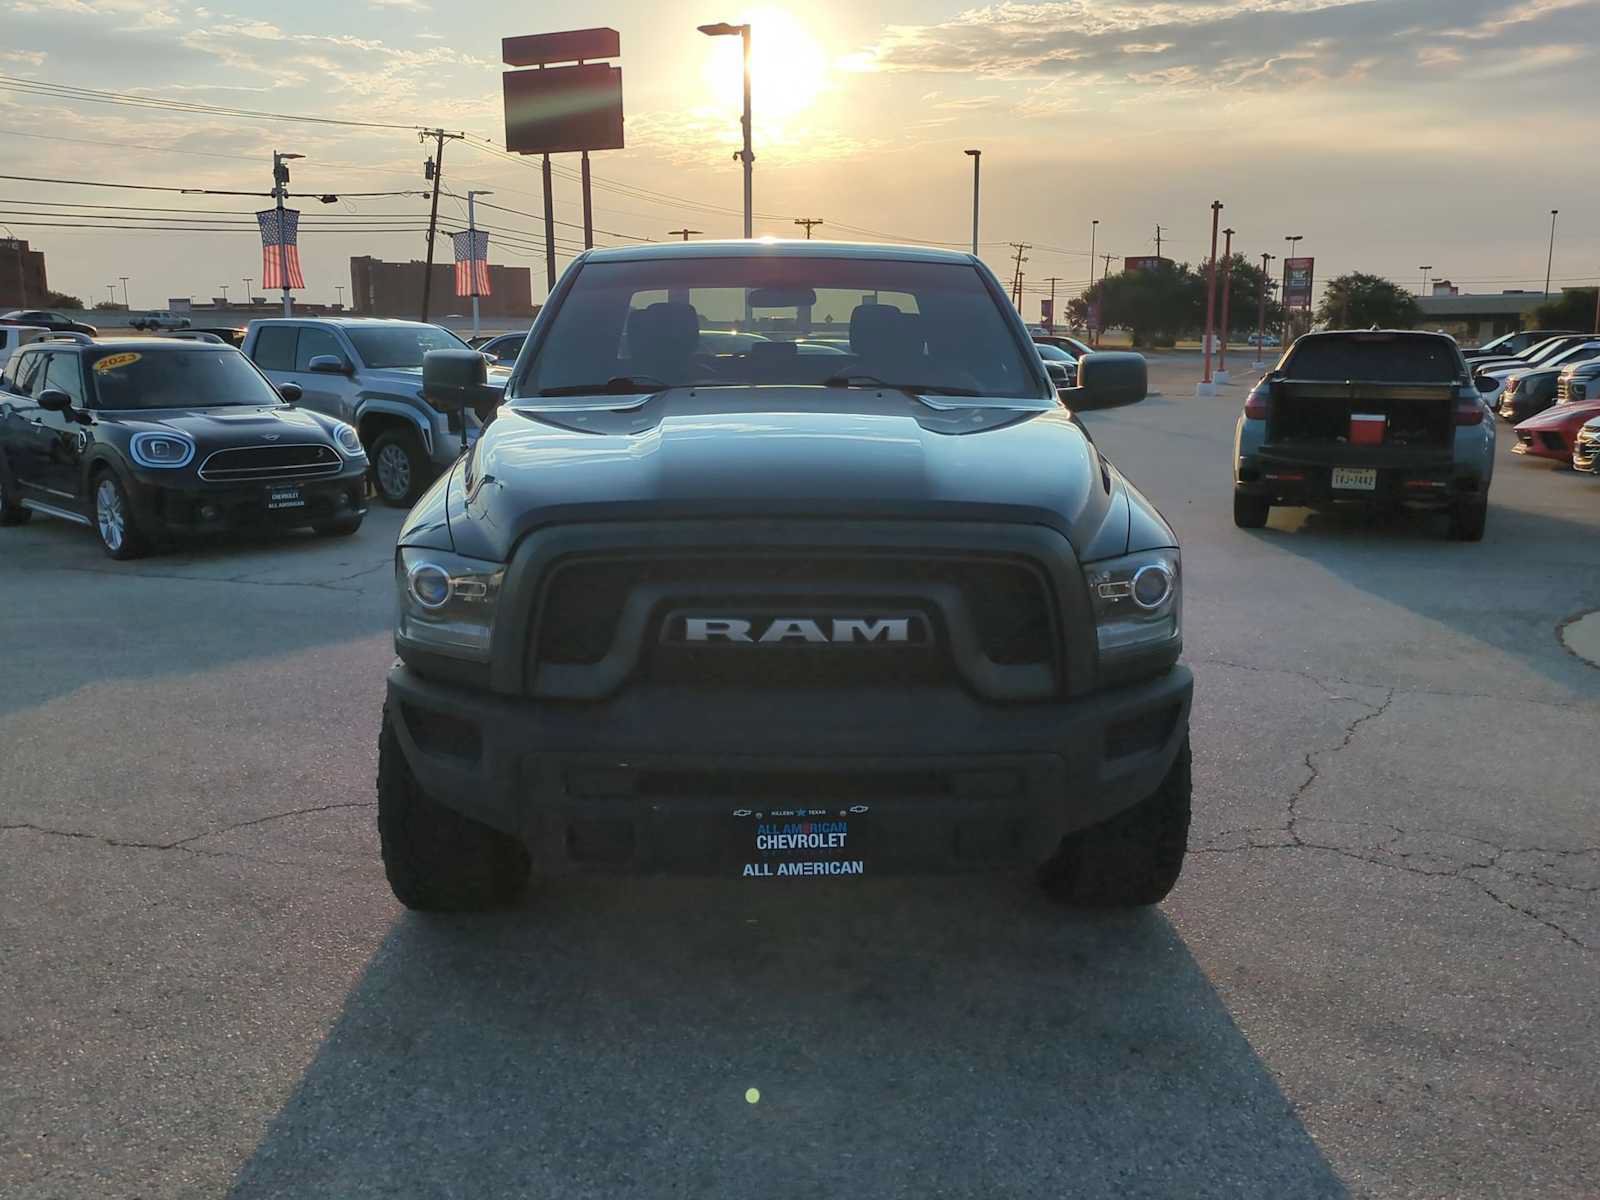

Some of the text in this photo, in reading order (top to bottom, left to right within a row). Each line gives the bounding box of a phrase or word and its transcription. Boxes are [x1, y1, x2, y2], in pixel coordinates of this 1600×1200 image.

[686, 618, 909, 642] RAM
[757, 822, 848, 834] ALL AMERICAN
[756, 833, 848, 849] CHEVROLET
[742, 860, 864, 877] ALL AMERICAN
